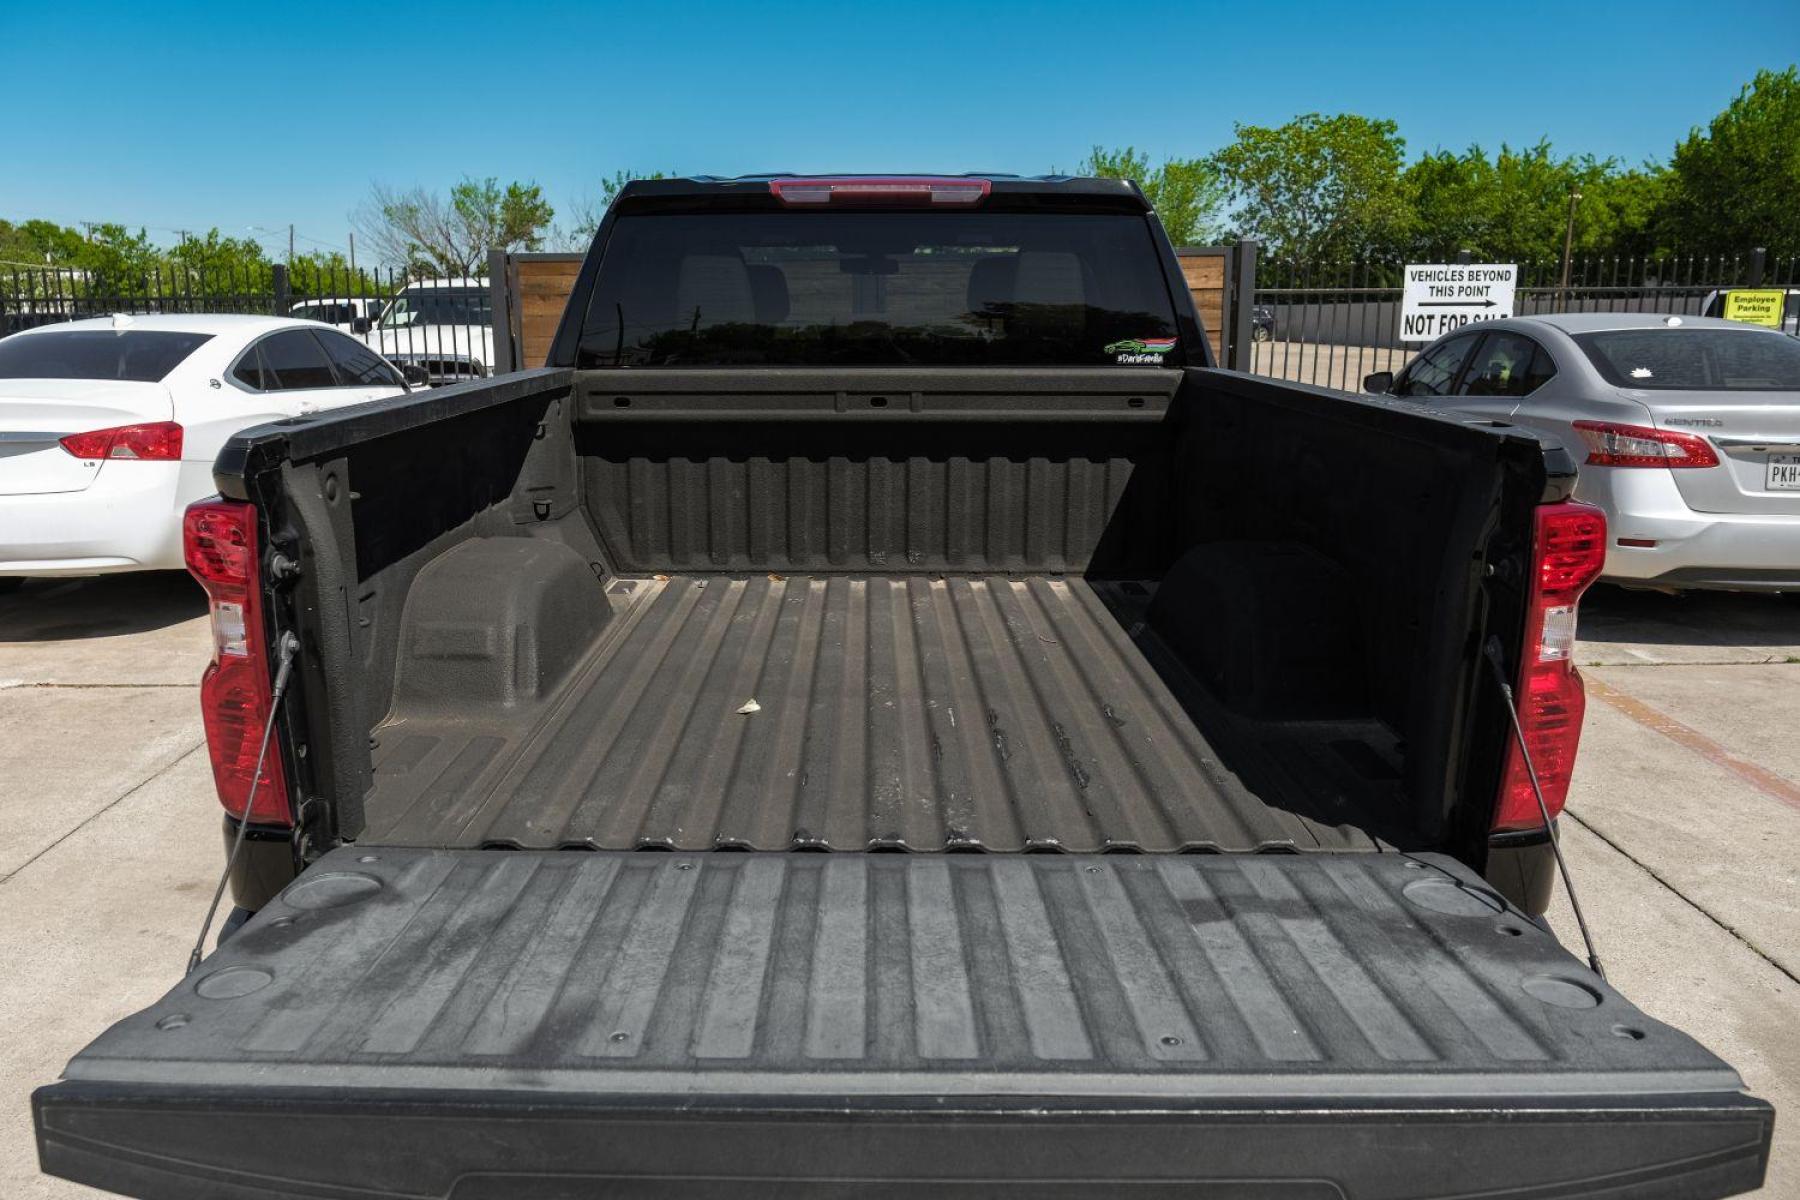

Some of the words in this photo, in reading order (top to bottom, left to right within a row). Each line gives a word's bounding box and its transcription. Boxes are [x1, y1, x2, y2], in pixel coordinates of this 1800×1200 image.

[1410, 270, 1465, 281] VEHICLES
[1468, 270, 1511, 281] BEYOND
[1429, 286, 1454, 297] THIS
[1457, 286, 1491, 297] POINT
[1734, 295, 1776, 304] Employee
[1737, 304, 1771, 312] Parking
[1404, 314, 1435, 335] NOT
[1664, 418, 1723, 427] SENTRA
